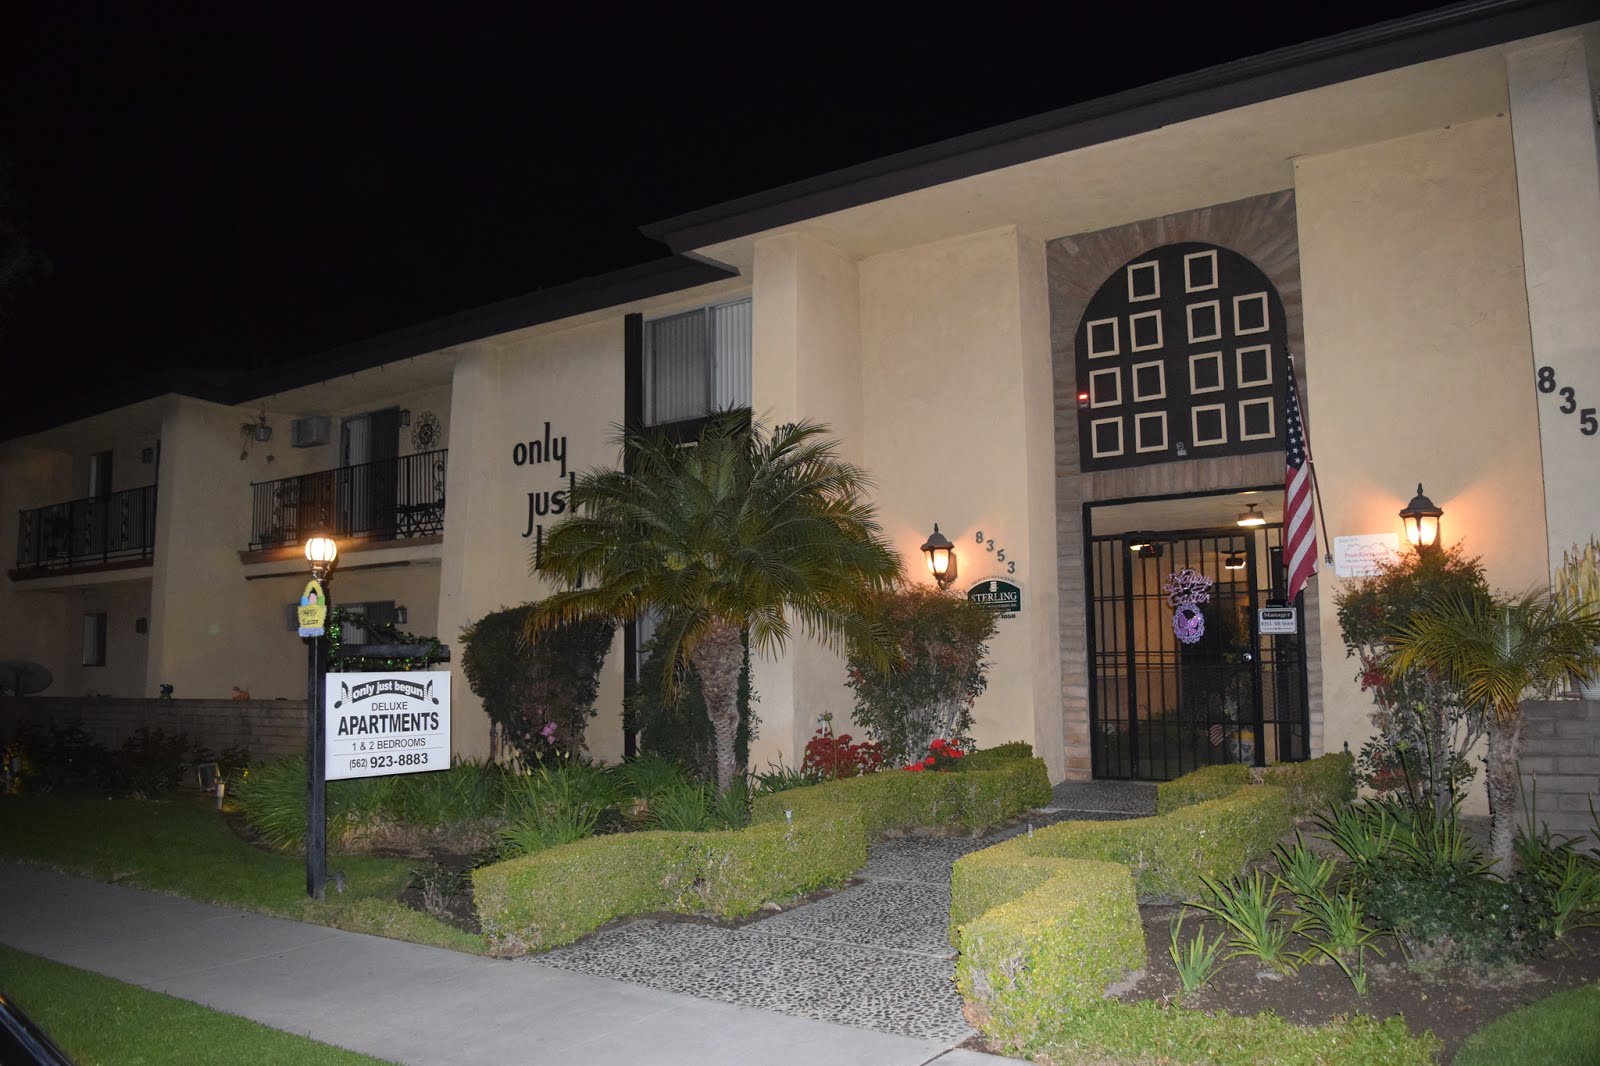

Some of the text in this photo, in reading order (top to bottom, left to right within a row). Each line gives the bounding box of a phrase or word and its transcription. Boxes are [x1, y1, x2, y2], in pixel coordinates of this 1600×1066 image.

[512, 421, 567, 478] only
[975, 530, 1016, 575] 8353
[971, 591, 1018, 602] STERLING
[352, 681, 424, 699] only just begun
[371, 701, 408, 711] DELUXE
[338, 712, 439, 736] APARTMENTS
[352, 738, 426, 751] 1 & 2 BEDROOMS
[349, 752, 429, 770] (562) 923-8883
